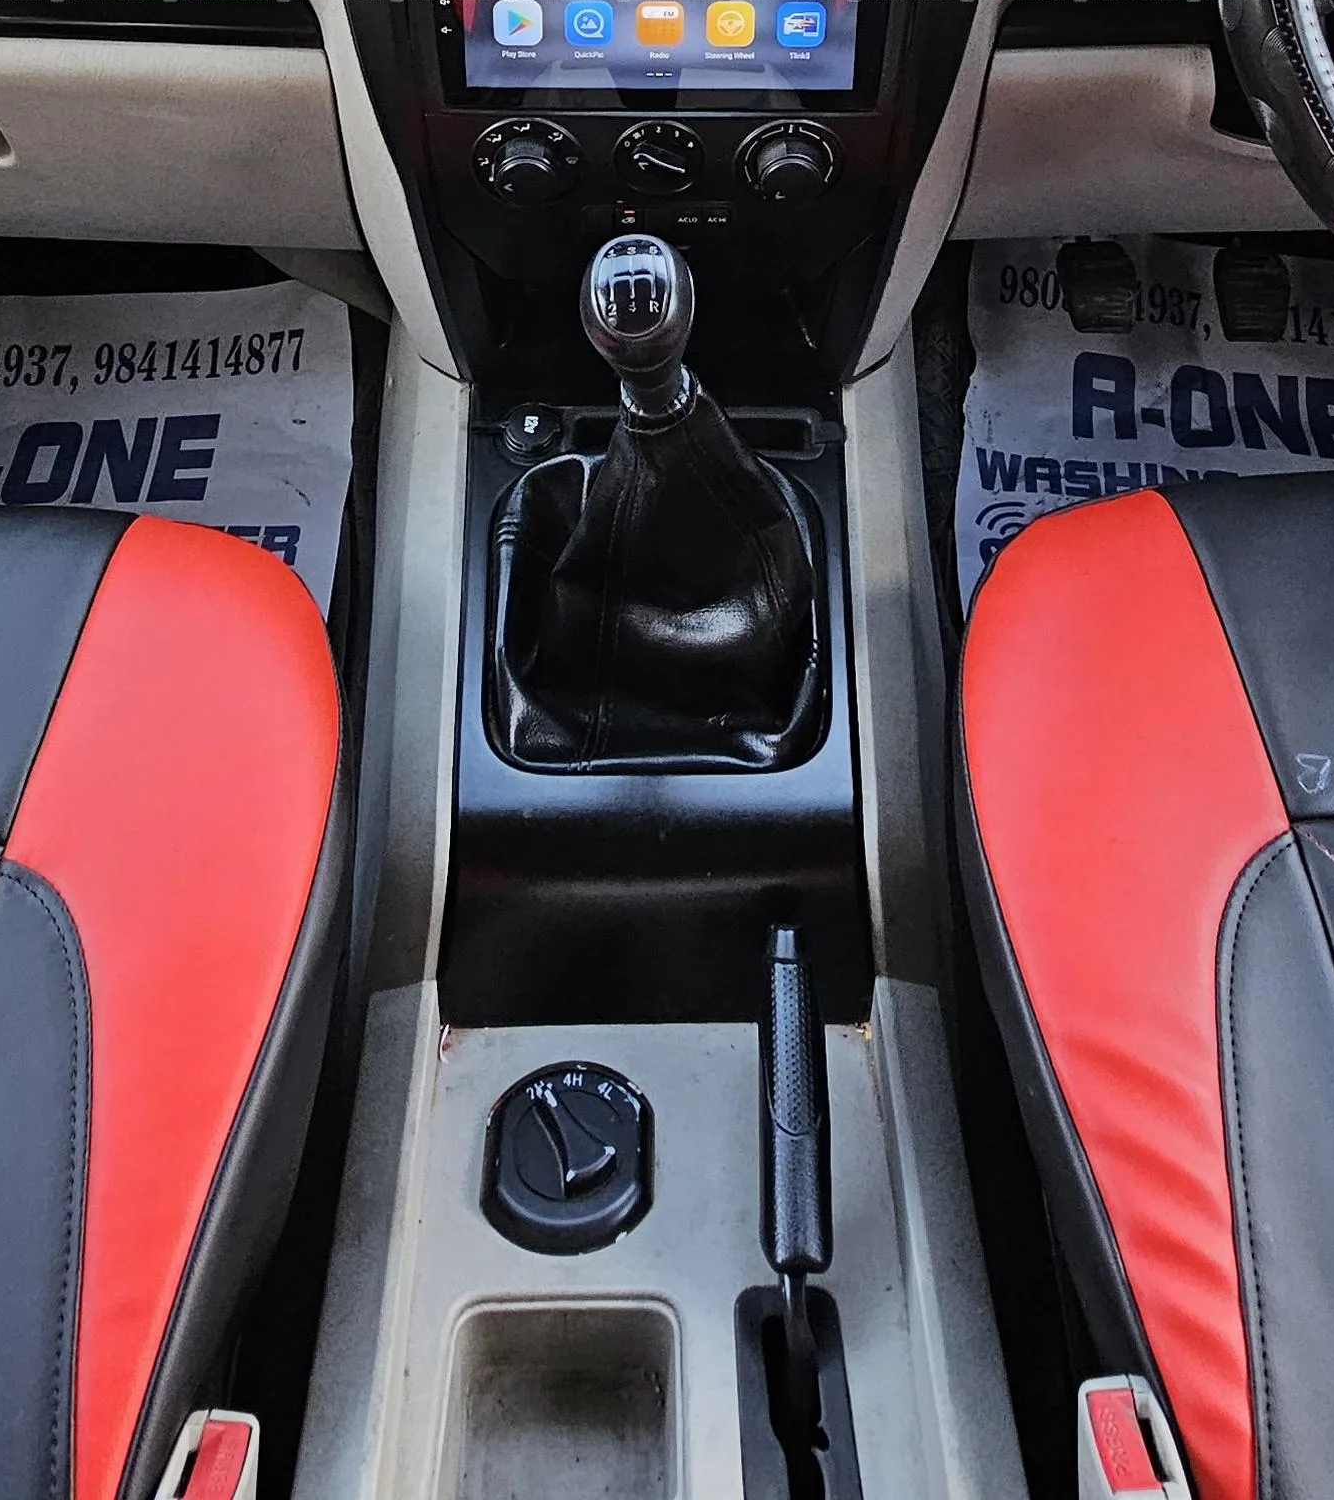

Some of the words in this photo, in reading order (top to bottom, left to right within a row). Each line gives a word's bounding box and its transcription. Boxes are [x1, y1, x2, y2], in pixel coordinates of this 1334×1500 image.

[501, 50, 516, 59] Play
[518, 50, 536, 58] Store
[705, 52, 733, 60] Steering
[607, 248, 617, 258] 1
[627, 246, 636, 255] 3
[649, 245, 659, 255] 5
[607, 303, 617, 316] 2
[649, 300, 660, 313] R
[1000, 265, 1211, 341] 980937,
[94, 328, 305, 387] 9841414877
[975, 446, 1240, 500] WASHI
[563, 1073, 583, 1087] 4H
[597, 1082, 613, 1101] 4L
